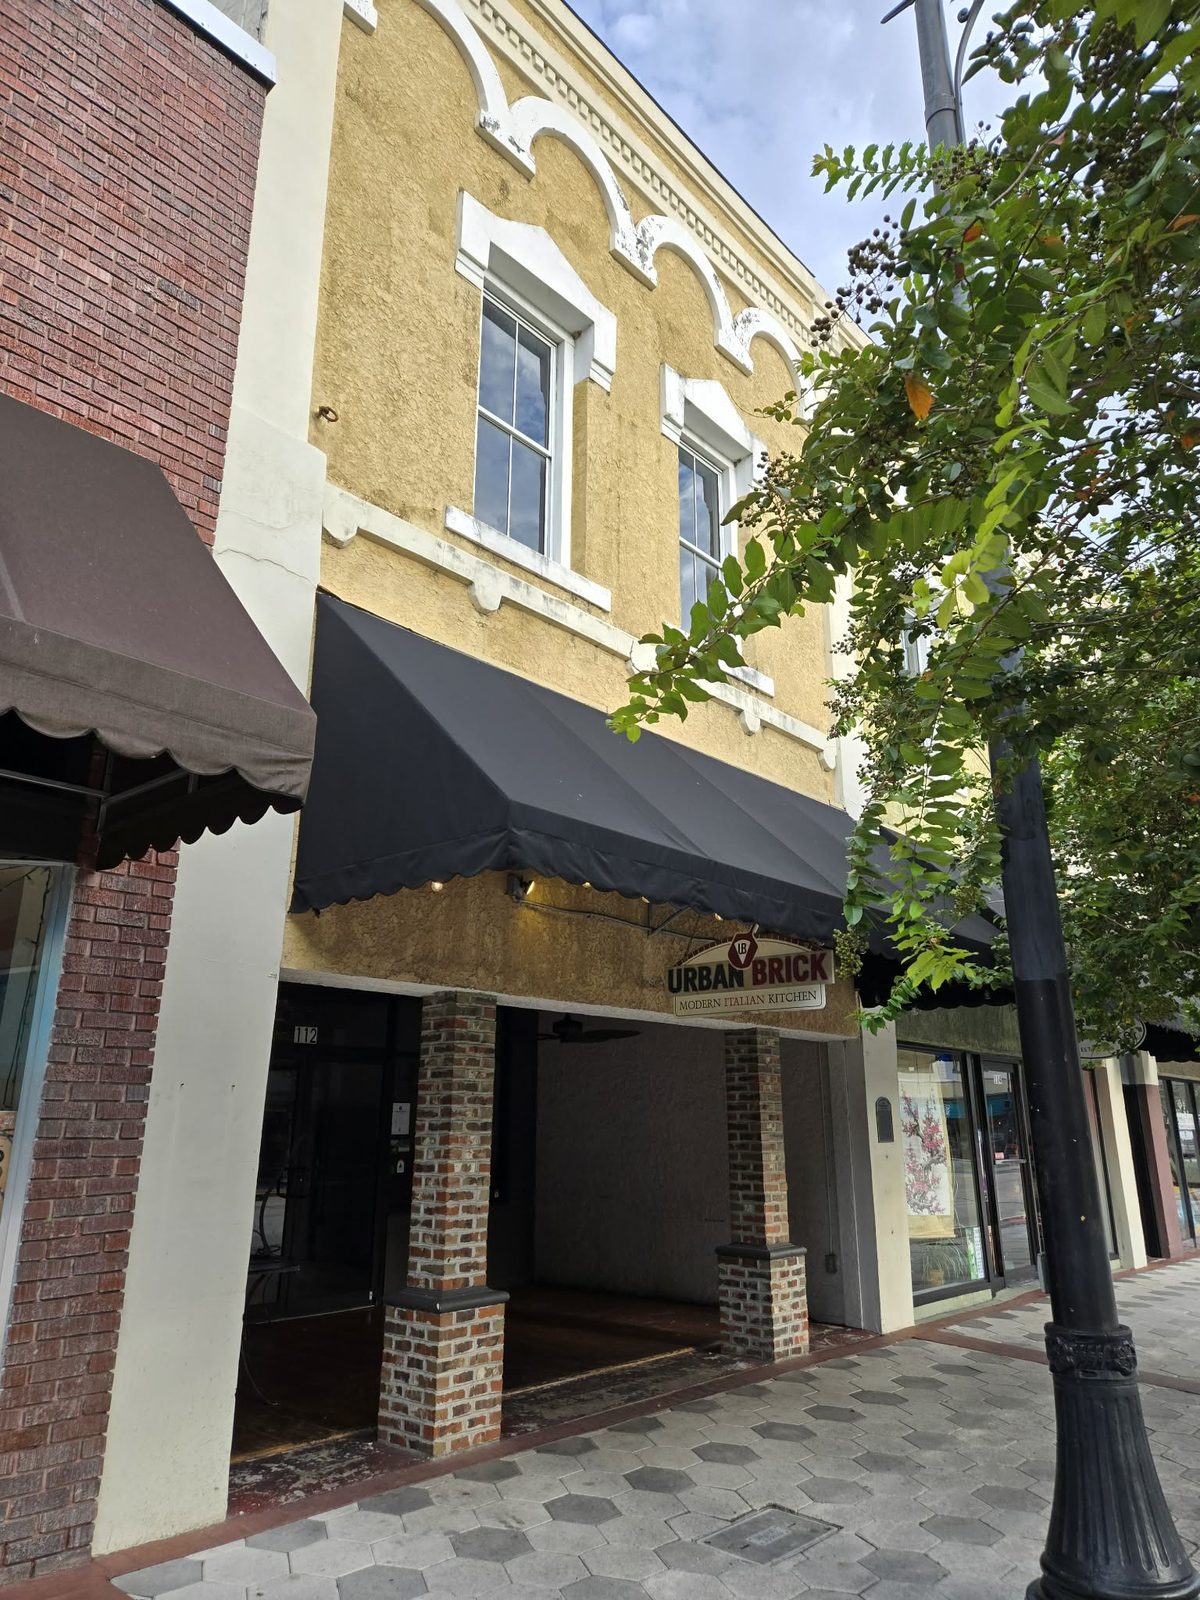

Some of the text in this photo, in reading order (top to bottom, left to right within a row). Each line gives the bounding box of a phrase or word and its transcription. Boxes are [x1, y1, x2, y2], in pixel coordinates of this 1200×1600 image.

[737, 943, 747, 954] UB
[668, 953, 828, 993] URBAN BRICK
[679, 990, 817, 1011] MODERN ITALIAN KITCHEN
[297, 1027, 317, 1044] 112
